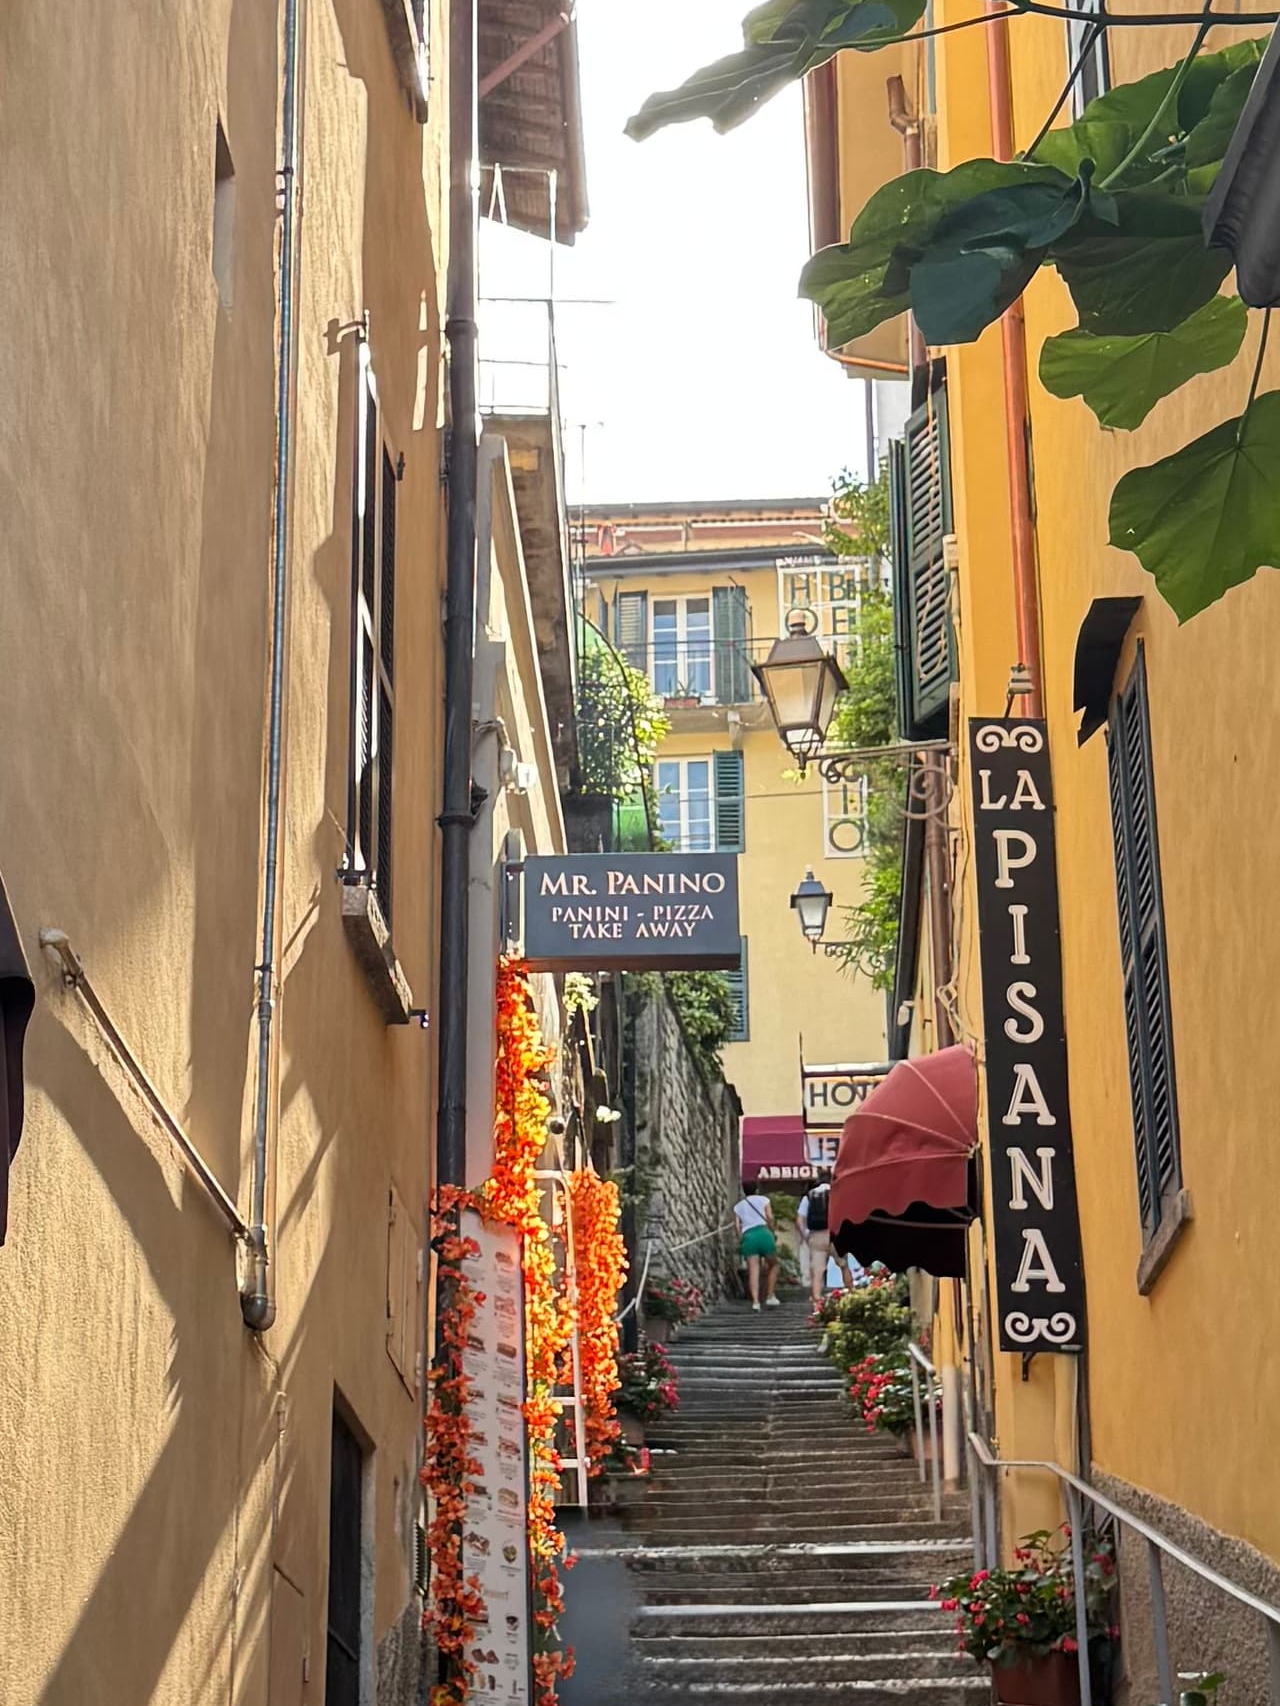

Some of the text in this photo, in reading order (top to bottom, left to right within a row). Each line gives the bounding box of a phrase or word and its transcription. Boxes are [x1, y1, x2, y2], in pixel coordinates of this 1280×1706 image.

[979, 768, 1046, 811] LA
[540, 870, 726, 896] MR. PANINO
[551, 905, 630, 923] PANINI
[652, 904, 714, 921] PIZZA
[568, 921, 696, 939] TAKE AWAY
[991, 828, 1066, 1294] PISANA
[810, 1082, 878, 1107] HOT
